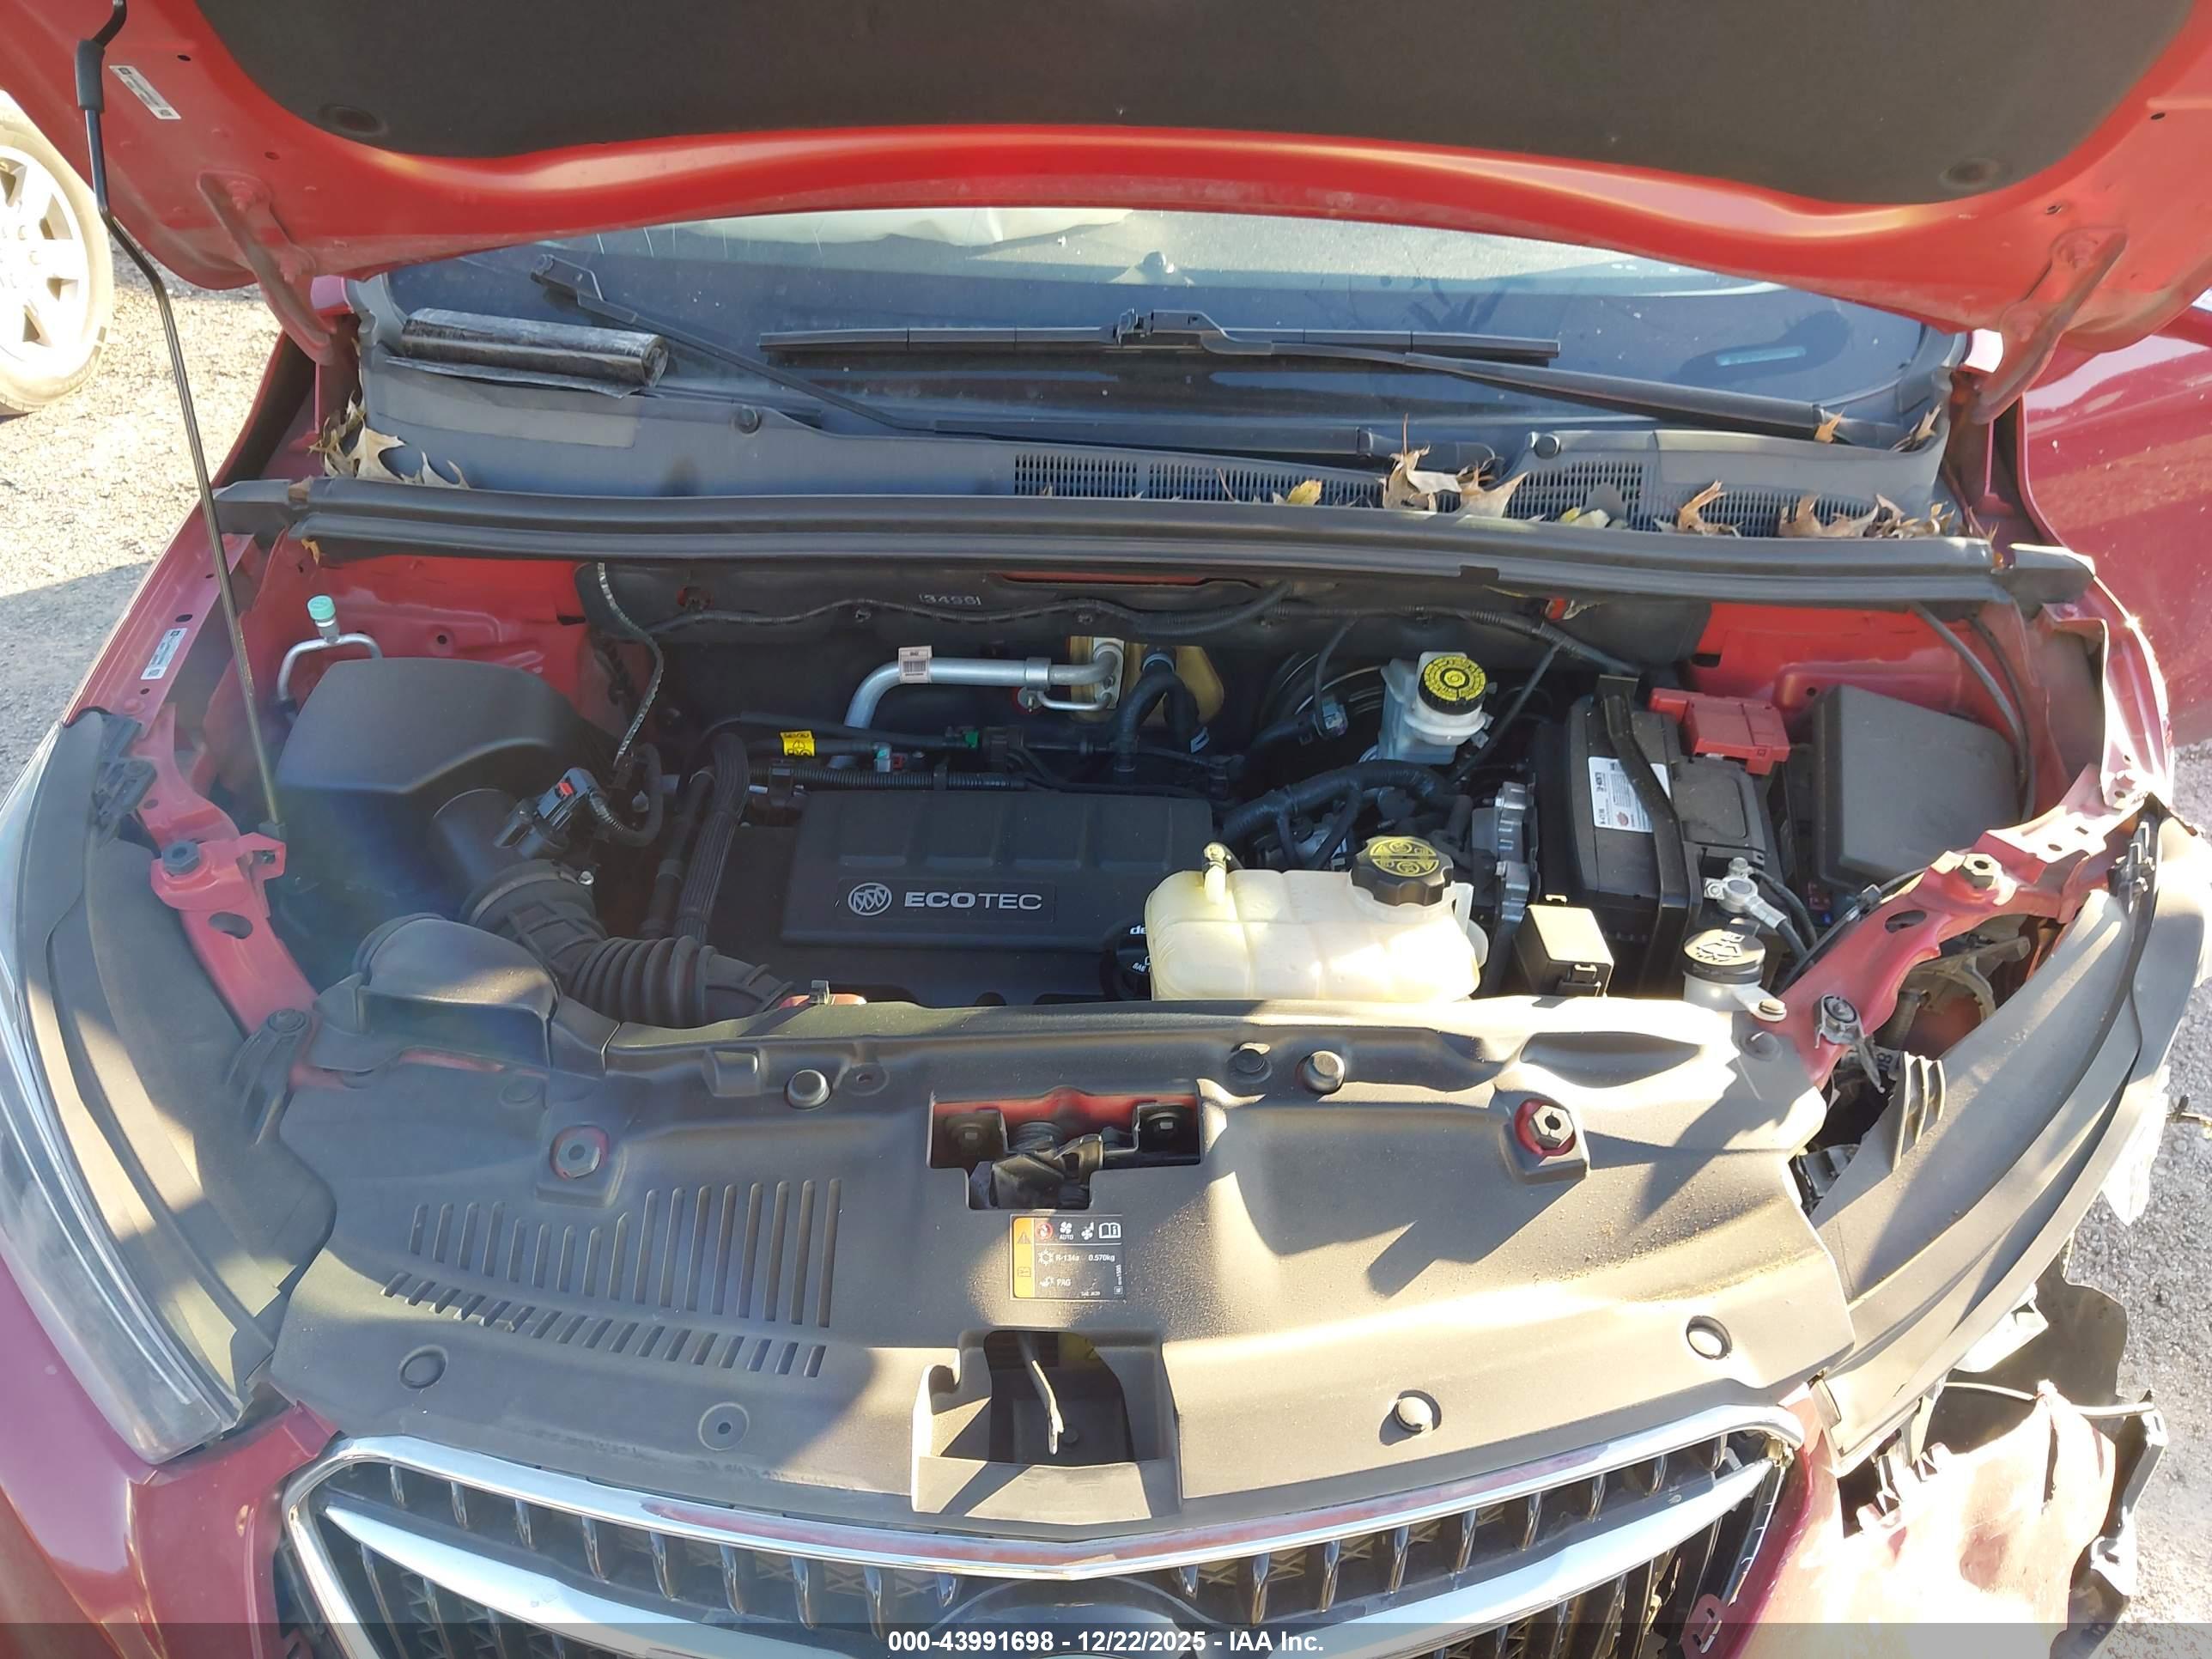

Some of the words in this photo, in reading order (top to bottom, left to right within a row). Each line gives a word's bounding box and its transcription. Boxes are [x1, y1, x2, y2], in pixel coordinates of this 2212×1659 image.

[904, 891, 1042, 910] ECOTEC
[1088, 1254, 1115, 1262] 0.570kg
[1056, 1278, 1072, 1287] PAG
